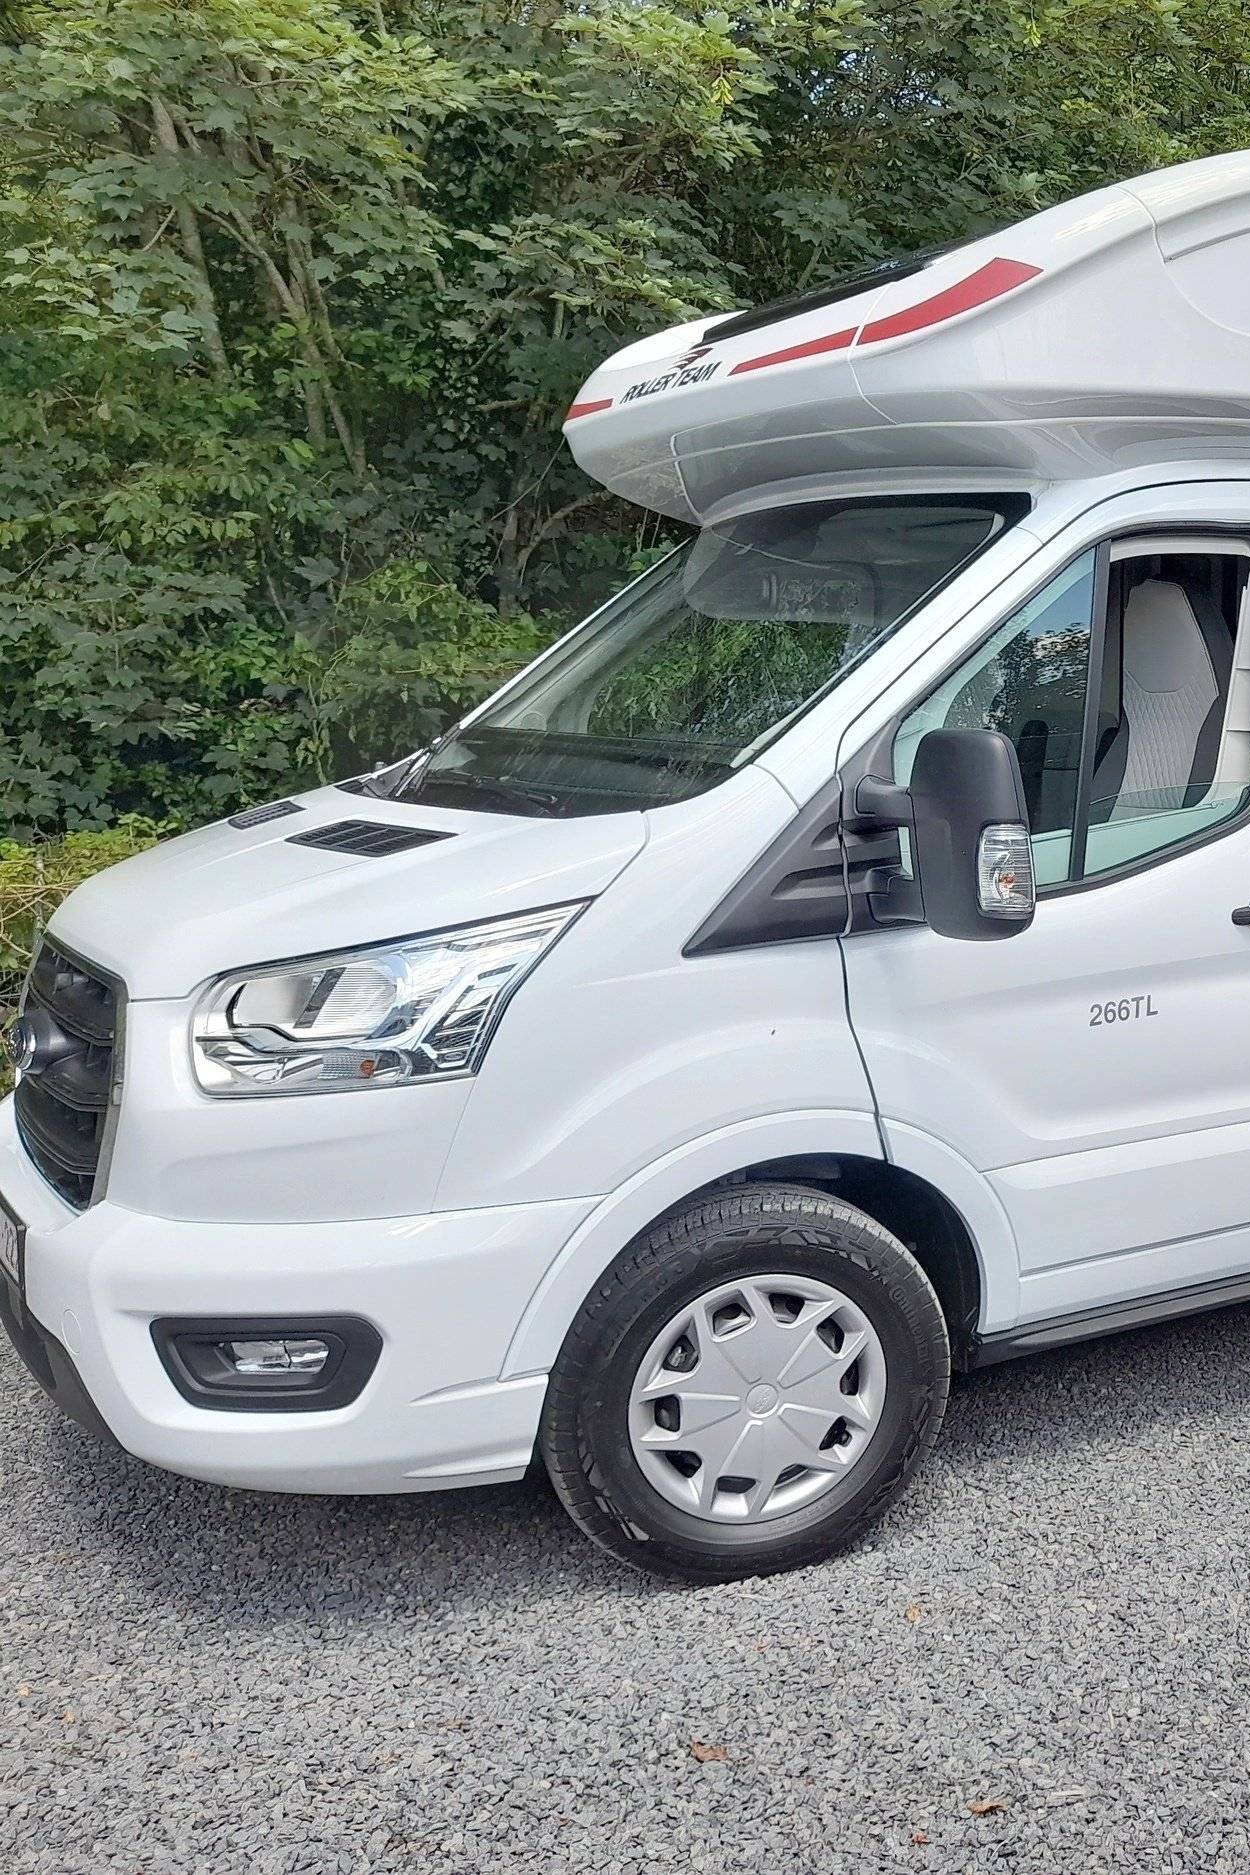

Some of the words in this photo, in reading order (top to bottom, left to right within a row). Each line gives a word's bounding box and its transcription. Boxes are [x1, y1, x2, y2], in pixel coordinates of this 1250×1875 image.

[619, 372, 674, 405] ROLLER
[671, 361, 723, 389] TEAM
[1089, 994, 1159, 1027] 266TL
